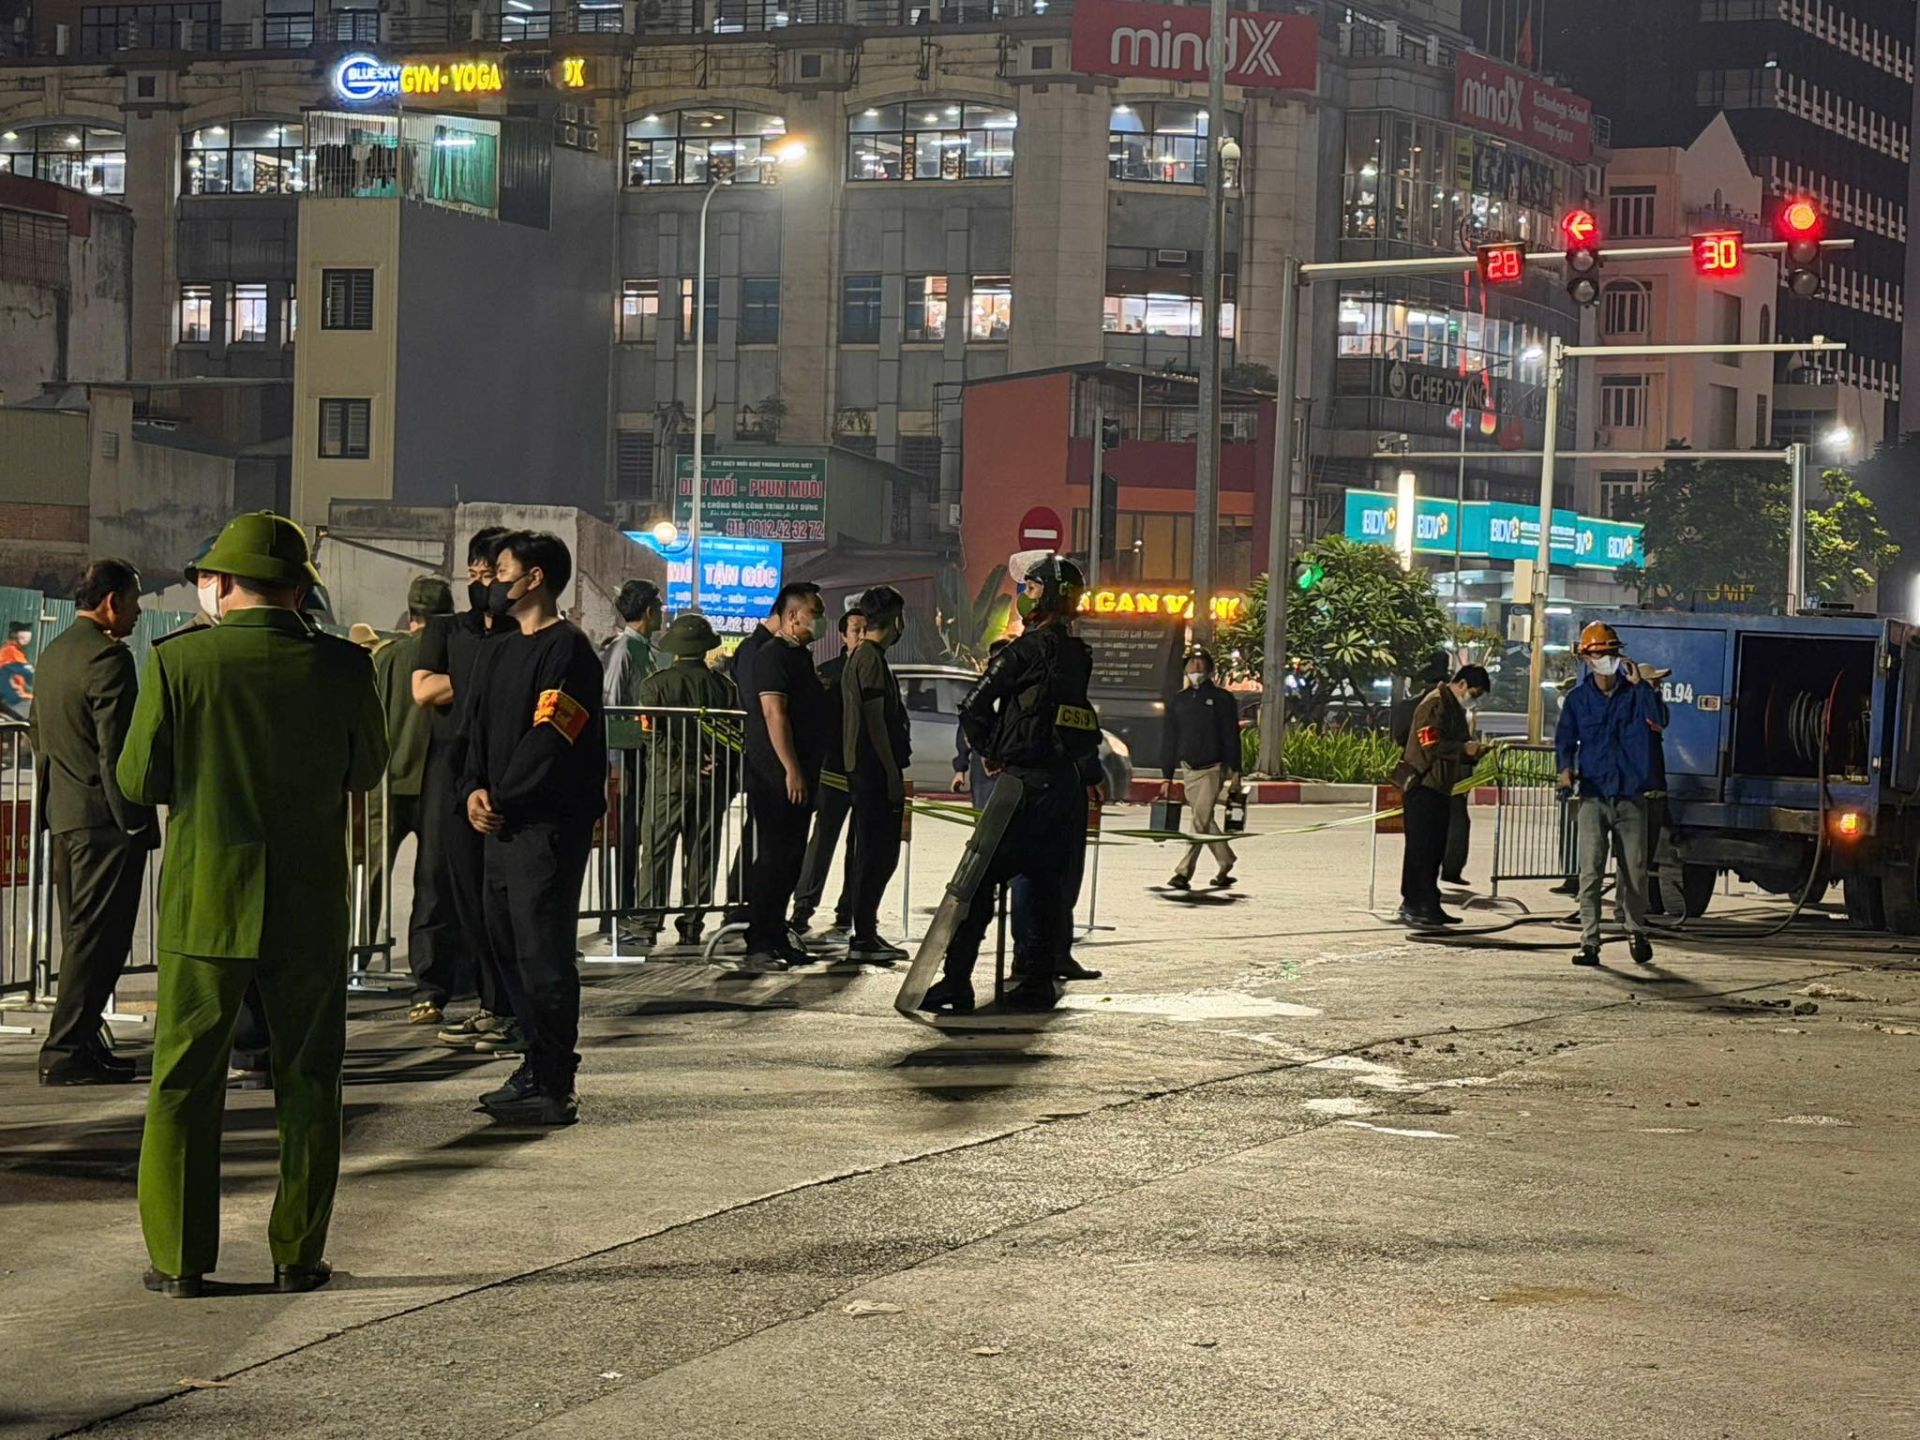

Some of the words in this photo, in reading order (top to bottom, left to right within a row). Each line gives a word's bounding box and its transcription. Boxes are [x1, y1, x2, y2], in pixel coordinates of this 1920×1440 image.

[1110, 17, 1283, 77] mindX
[347, 64, 401, 81] BLUESKY
[401, 64, 440, 93] GYM
[450, 61, 503, 93] YOGA
[1462, 72, 1524, 131] mindX
[1487, 250, 1520, 280] 28
[1702, 240, 1737, 270] 30
[1410, 374, 1443, 402] CHEF
[679, 477, 709, 496] DIT
[749, 478, 787, 498] PHUN
[746, 518, 791, 539] 0912.42
[791, 519, 807, 540] 32
[808, 519, 825, 541] 72
[704, 560, 739, 589] TẬN
[741, 560, 778, 588] GỐC
